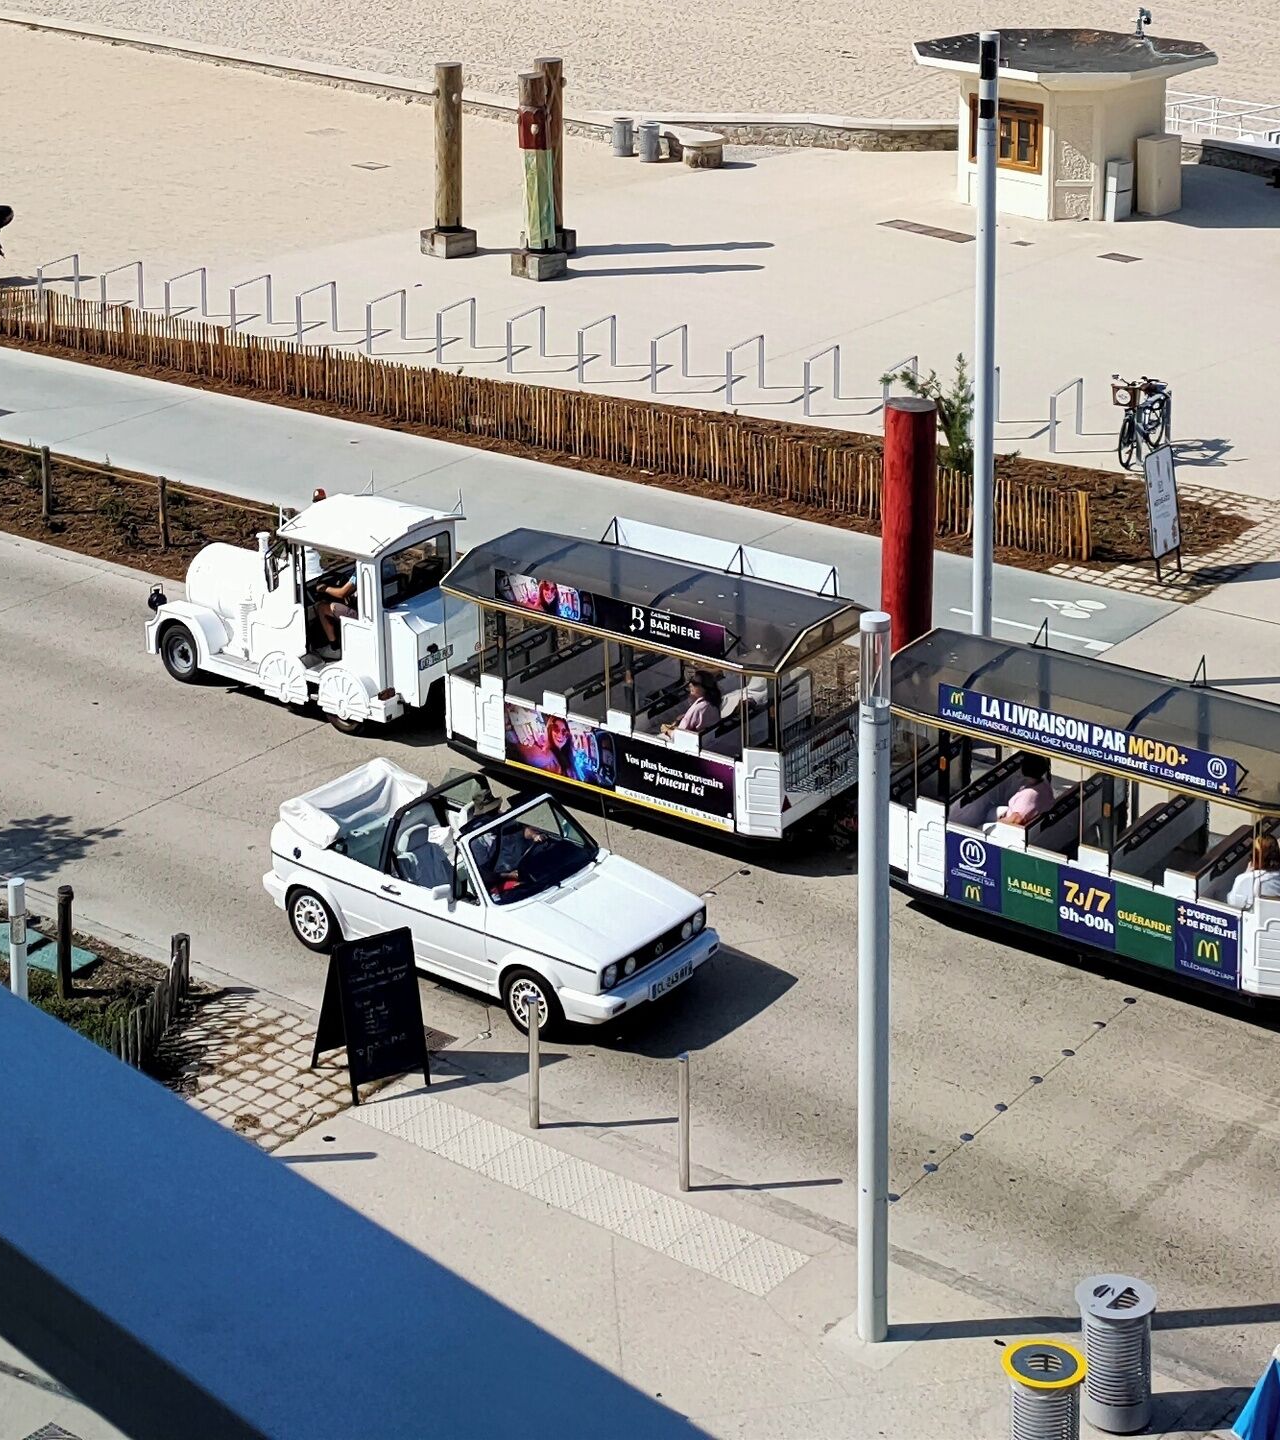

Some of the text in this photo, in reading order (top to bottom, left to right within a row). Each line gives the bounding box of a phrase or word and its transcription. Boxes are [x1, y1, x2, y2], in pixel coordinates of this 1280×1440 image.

[981, 696, 1188, 767] LA LIVRAISON PAR MCDO+
[942, 708, 951, 716] LA
[951, 710, 972, 723] MÊME
[972, 716, 1009, 733] LIVRAISON
[1041, 735, 1061, 747] CHEZ
[1061, 740, 1082, 753] VOUS
[1083, 747, 1102, 758] AVEC
[1104, 752, 1113, 761] LA
[1114, 754, 1148, 770] FIDÉLITÉ
[1149, 764, 1159, 773] ET
[1160, 767, 1174, 778] LES
[1174, 771, 1206, 786] OFFRES
[1206, 779, 1218, 789] EN
[625, 753, 724, 790] Vos plus beaux souvenirs
[643, 771, 655, 782] se
[655, 772, 690, 792] jouent
[1007, 876, 1052, 897] LA BAULE
[1059, 906, 1114, 934] 9h-00h
[1117, 909, 1172, 934] GUÉRANDE
[1186, 908, 1228, 927] D'OFFRES
[1186, 918, 1199, 929] DE
[1199, 922, 1238, 940] FIDÉLITÉ
